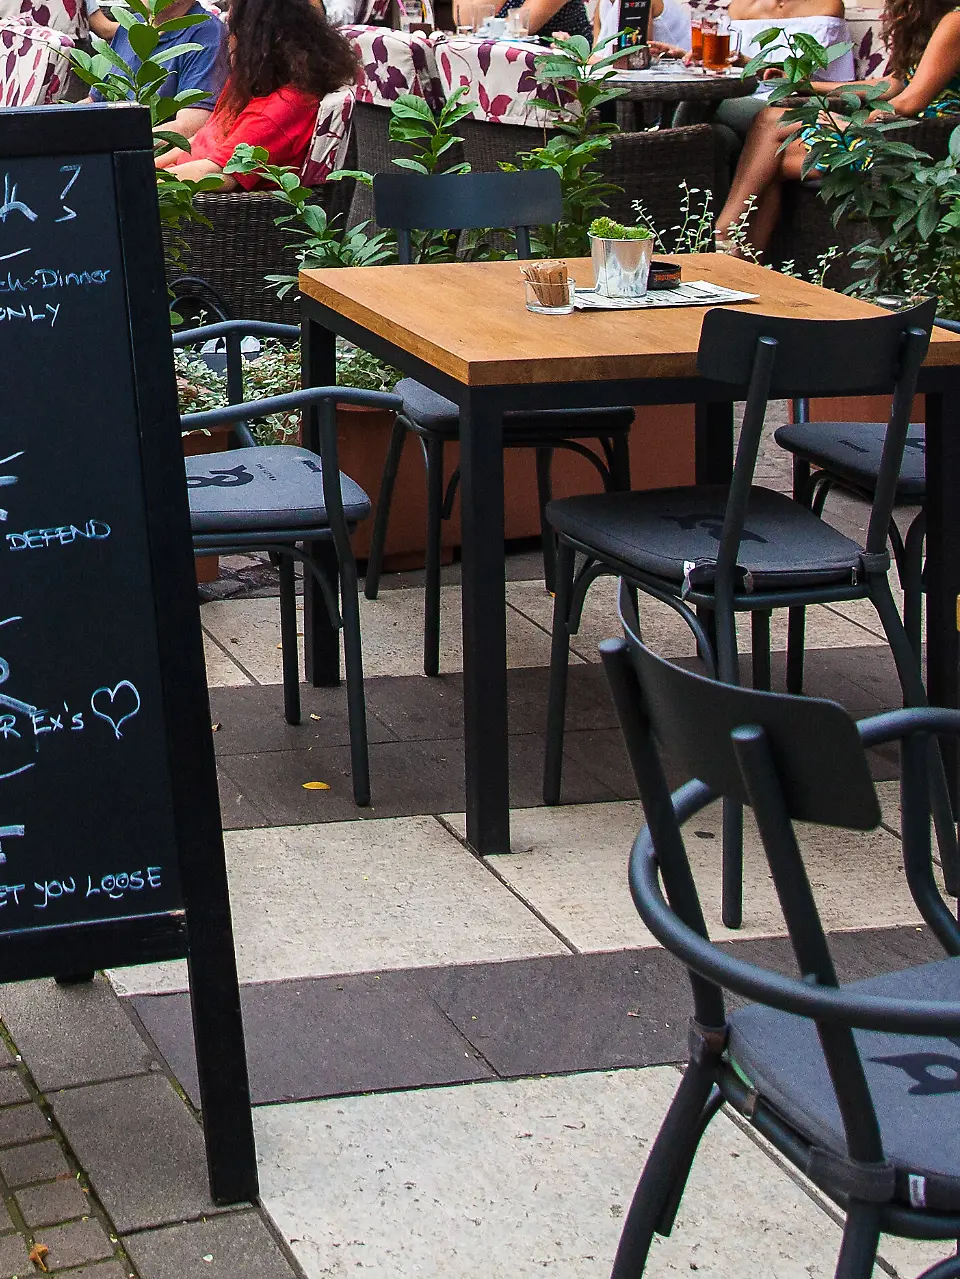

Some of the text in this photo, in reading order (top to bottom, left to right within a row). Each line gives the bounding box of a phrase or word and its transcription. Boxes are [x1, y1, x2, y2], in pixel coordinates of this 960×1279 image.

[34, 268, 111, 289] Dinner
[6, 519, 112, 551] DEFEND
[33, 875, 76, 908] YOU
[85, 866, 162, 900] LOOSE
